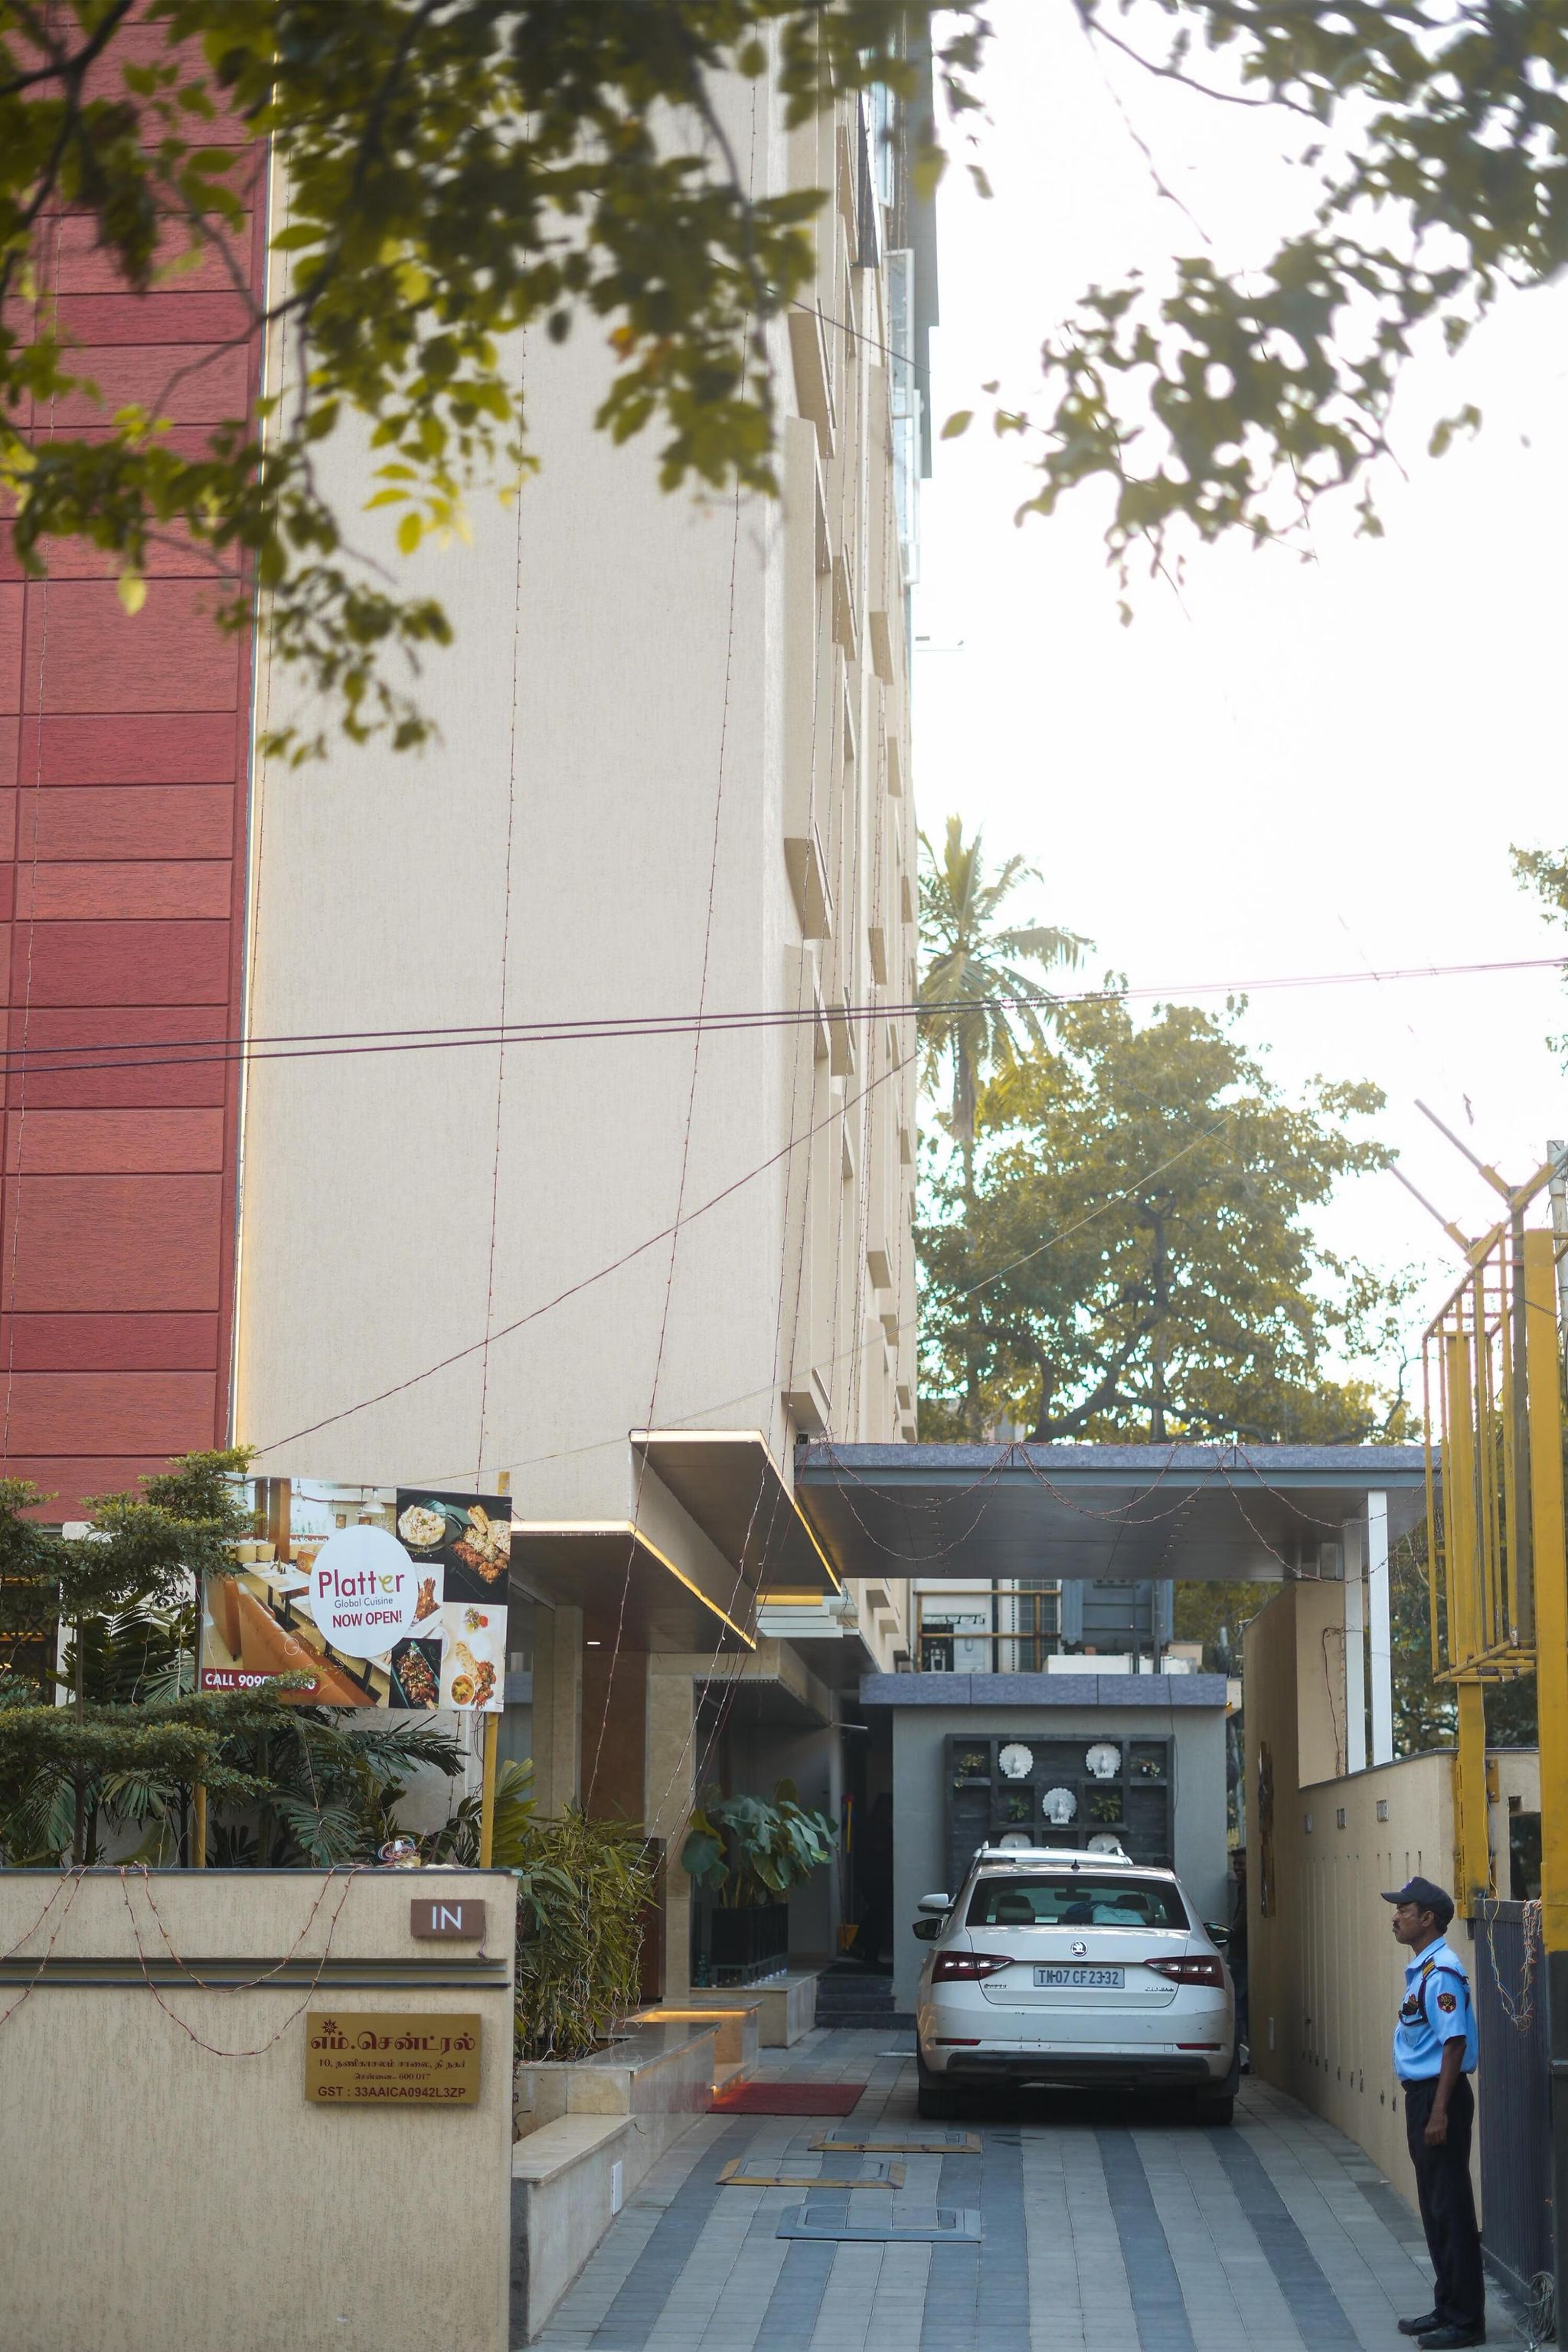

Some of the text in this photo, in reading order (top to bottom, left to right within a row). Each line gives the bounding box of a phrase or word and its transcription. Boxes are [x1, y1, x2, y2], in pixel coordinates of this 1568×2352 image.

[318, 1569, 405, 1599] Platter
[335, 1597, 394, 1609] Global Cuisine
[332, 1610, 402, 1628] NOW OPEN!
[205, 1674, 235, 1686] CALL
[432, 1906, 462, 1930] IN
[318, 2086, 344, 2096] GST
[354, 2087, 466, 2098] 33AAICA0942L3ZP
